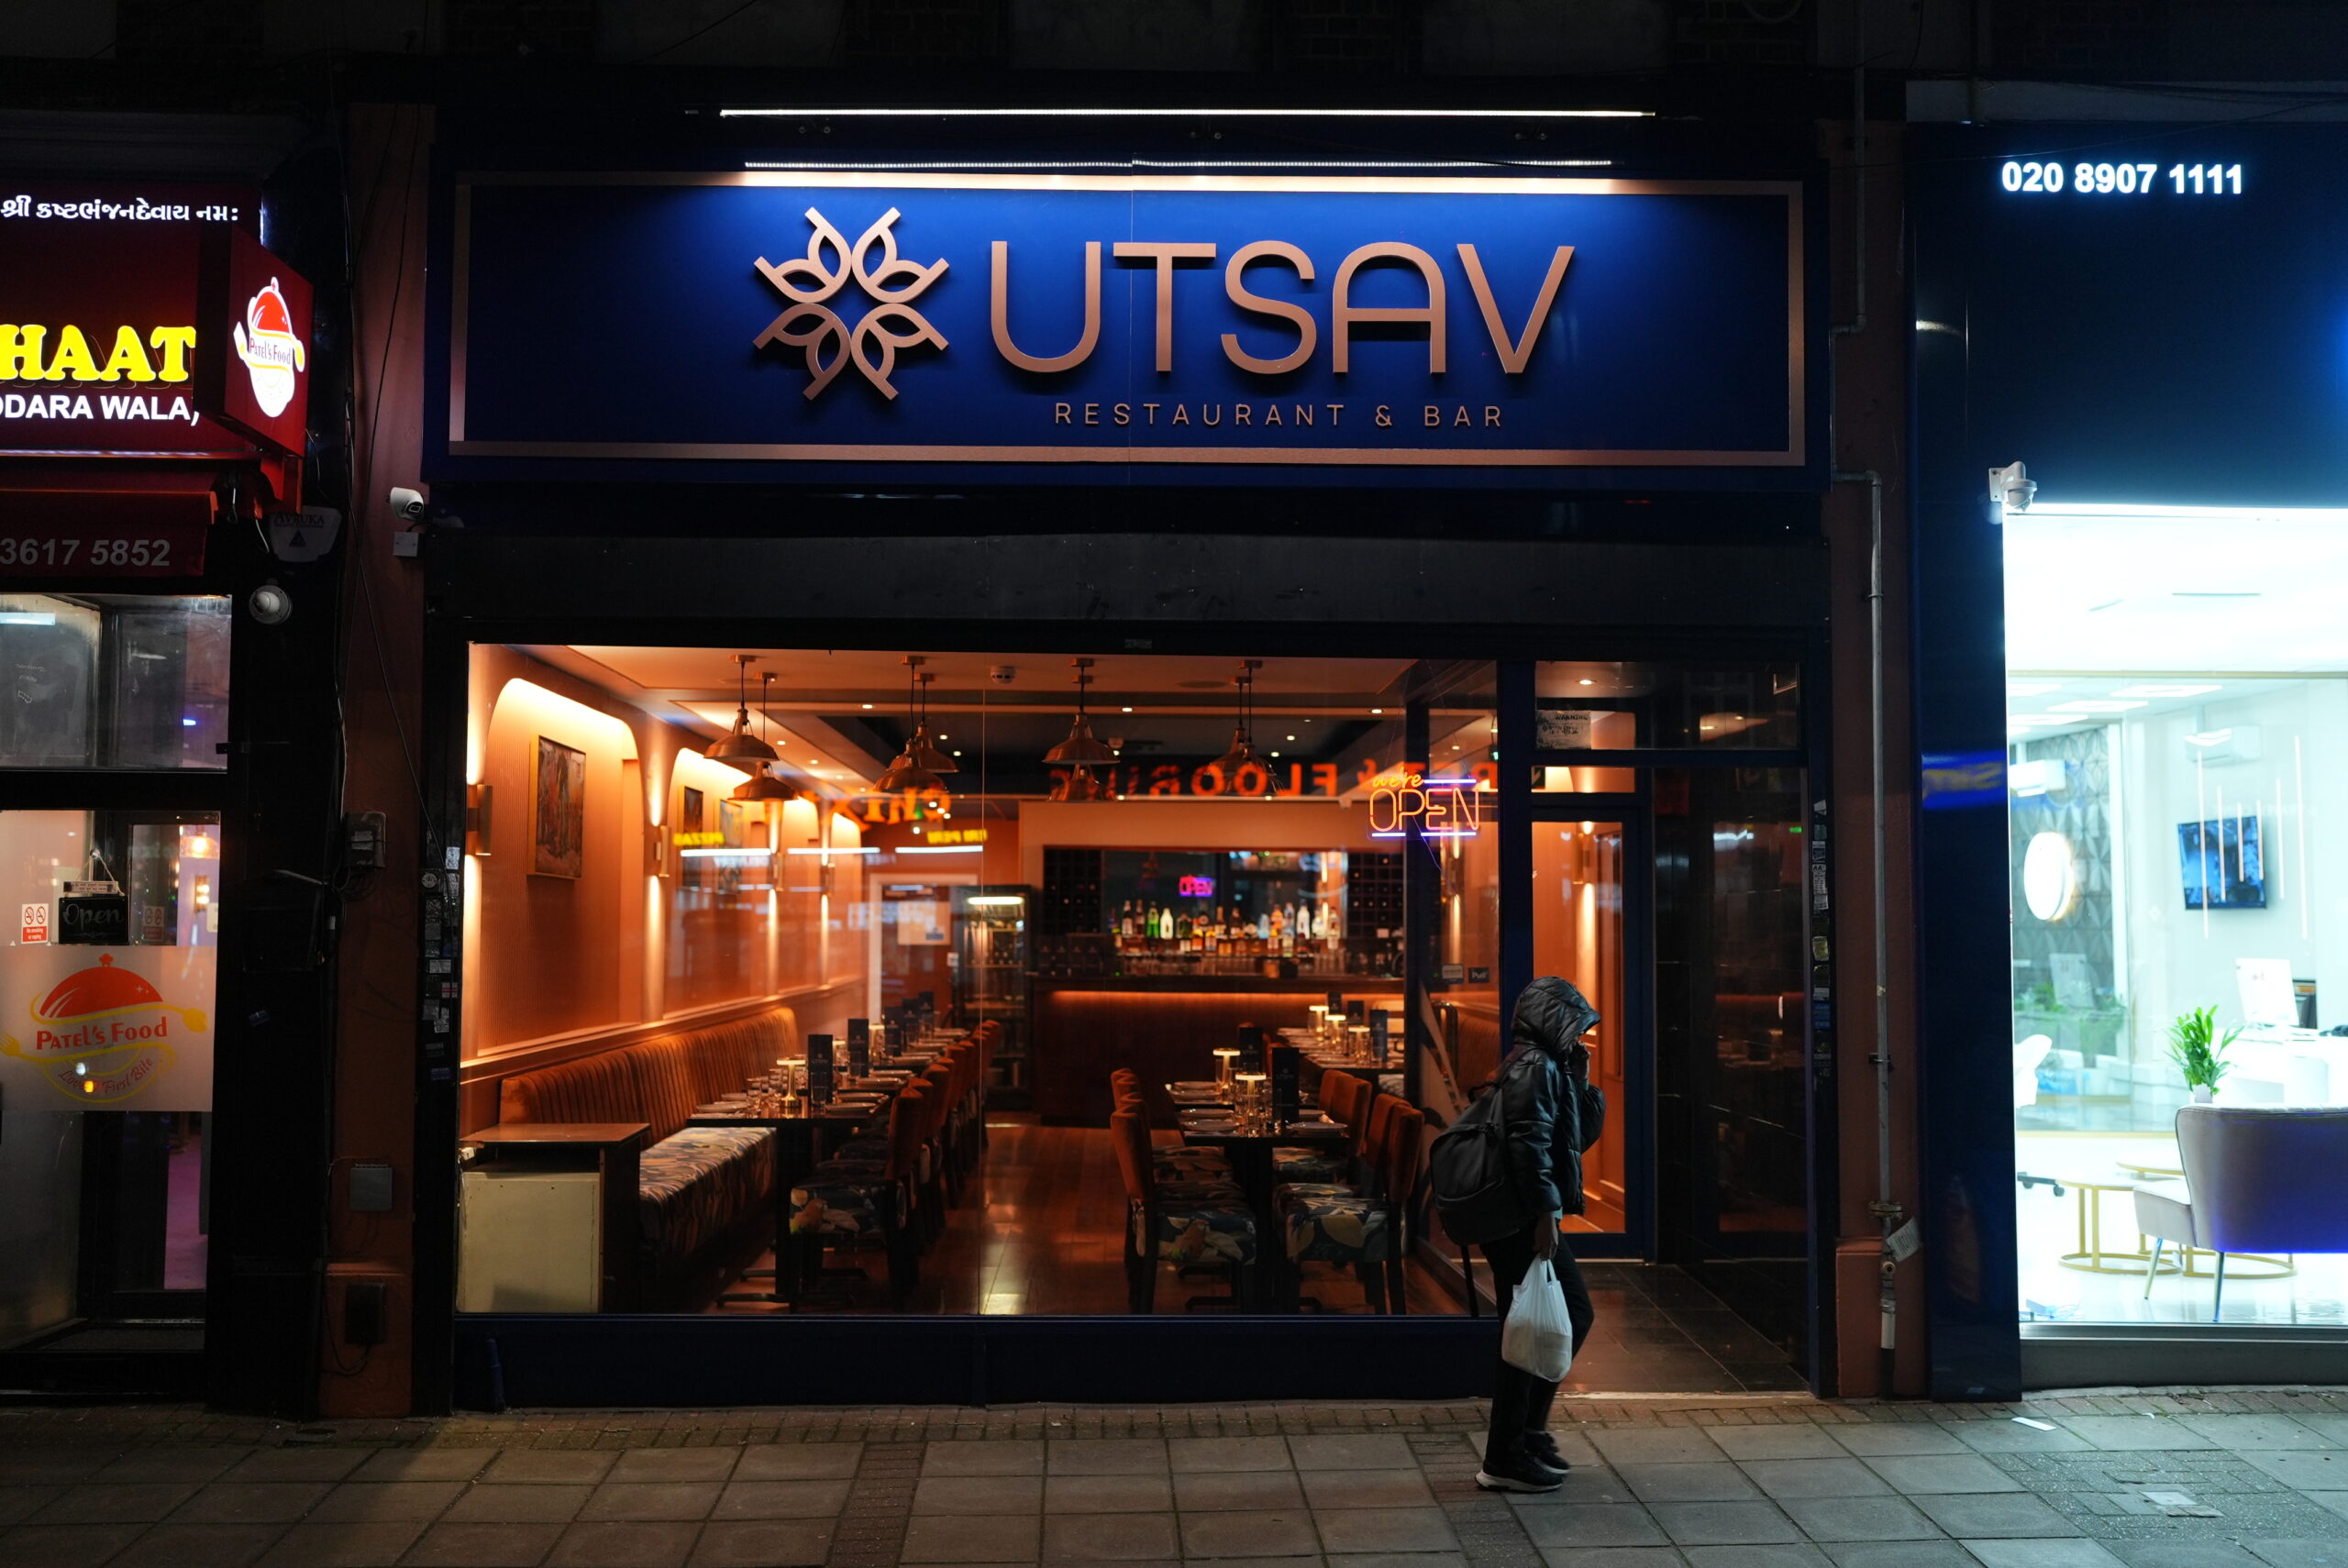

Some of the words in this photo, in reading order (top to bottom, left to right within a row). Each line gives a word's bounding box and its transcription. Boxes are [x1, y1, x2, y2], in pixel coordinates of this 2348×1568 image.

[2001, 161, 2064, 193] 020
[2074, 162, 2157, 193] 8907
[2168, 163, 2242, 194] 1111
[0, 194, 32, 217] શ્રી
[991, 239, 1575, 374] UTSAV
[0, 394, 94, 419] DARA
[100, 395, 199, 426] WALA,
[1055, 403, 1345, 426] RESTAURANT
[1375, 404, 1393, 427] &
[1423, 405, 1501, 427] BAR
[0, 538, 81, 566] 3617
[90, 539, 171, 567] 5852
[1372, 767, 1424, 789] we're
[1369, 788, 1479, 832] OPEN
[62, 903, 125, 932] Open
[110, 1015, 168, 1043] Food
[131, 1057, 154, 1081] Bite
